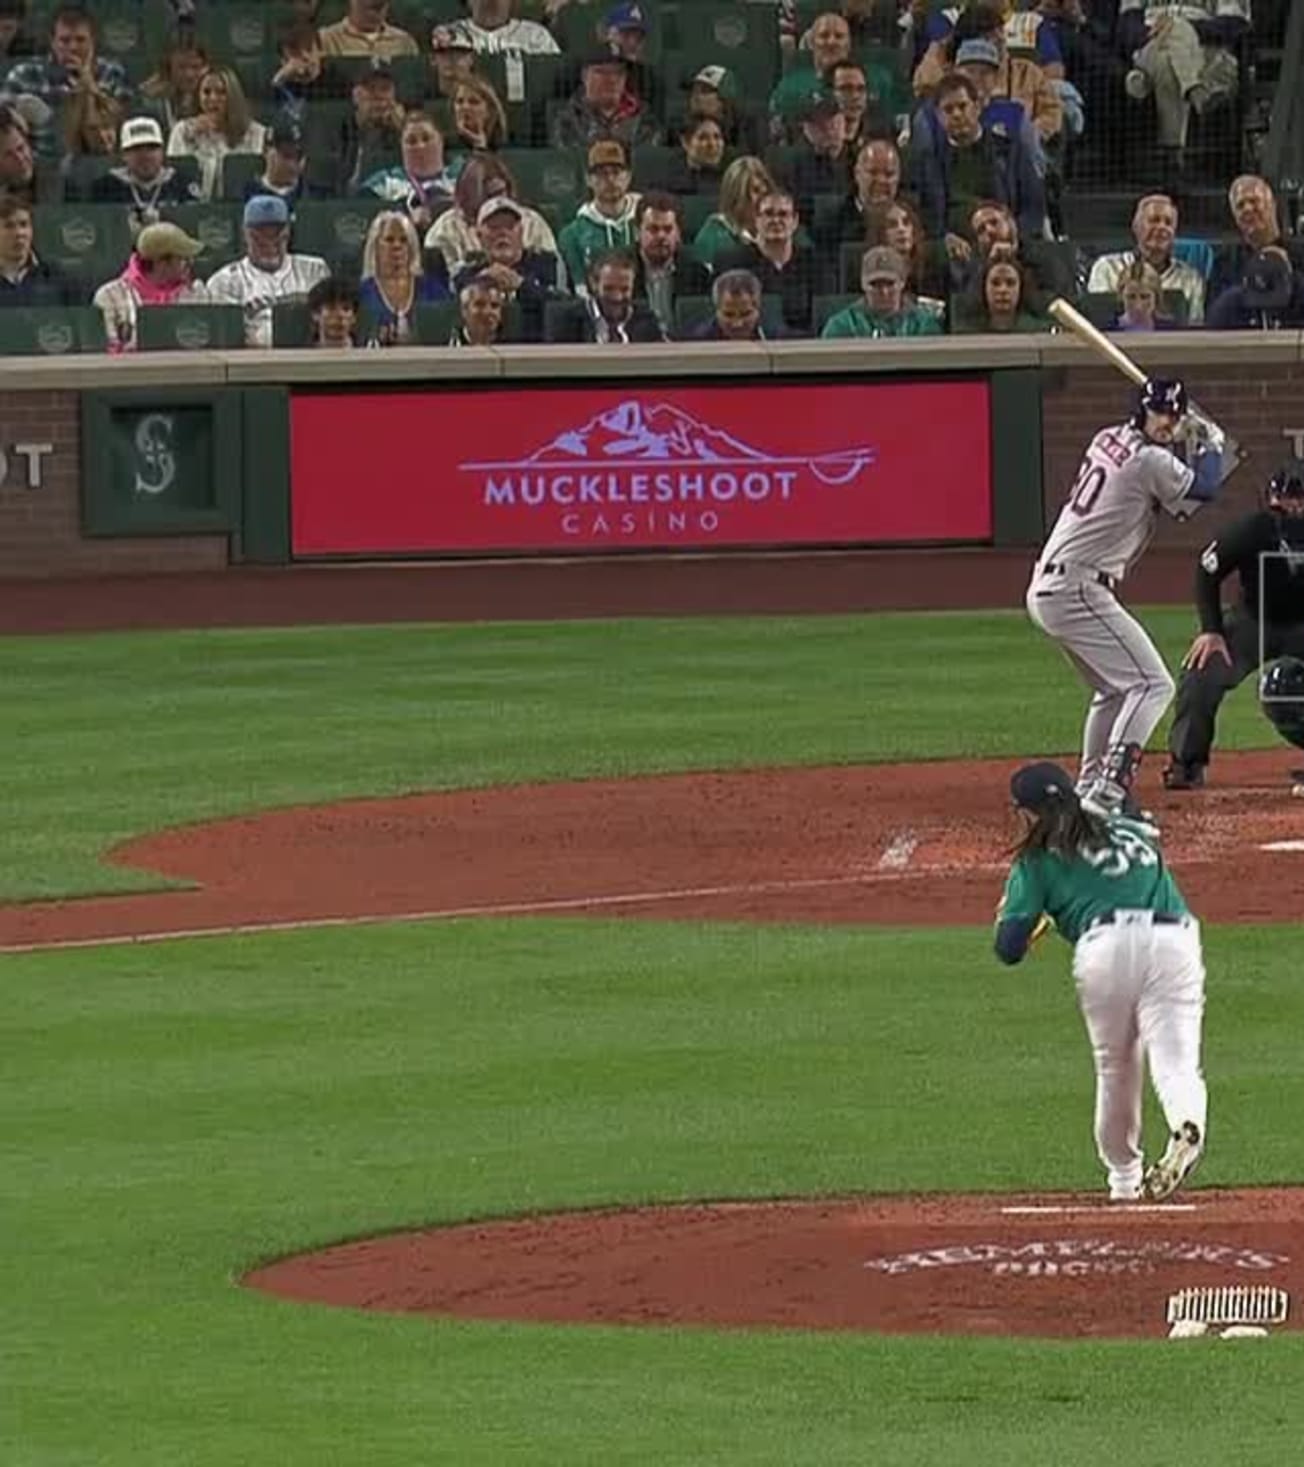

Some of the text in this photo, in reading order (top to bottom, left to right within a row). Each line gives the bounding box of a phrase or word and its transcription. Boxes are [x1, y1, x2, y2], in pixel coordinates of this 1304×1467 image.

[0, 443, 53, 487] T
[485, 471, 797, 505] MUCKLESHOOT
[561, 511, 719, 534] CASINO
